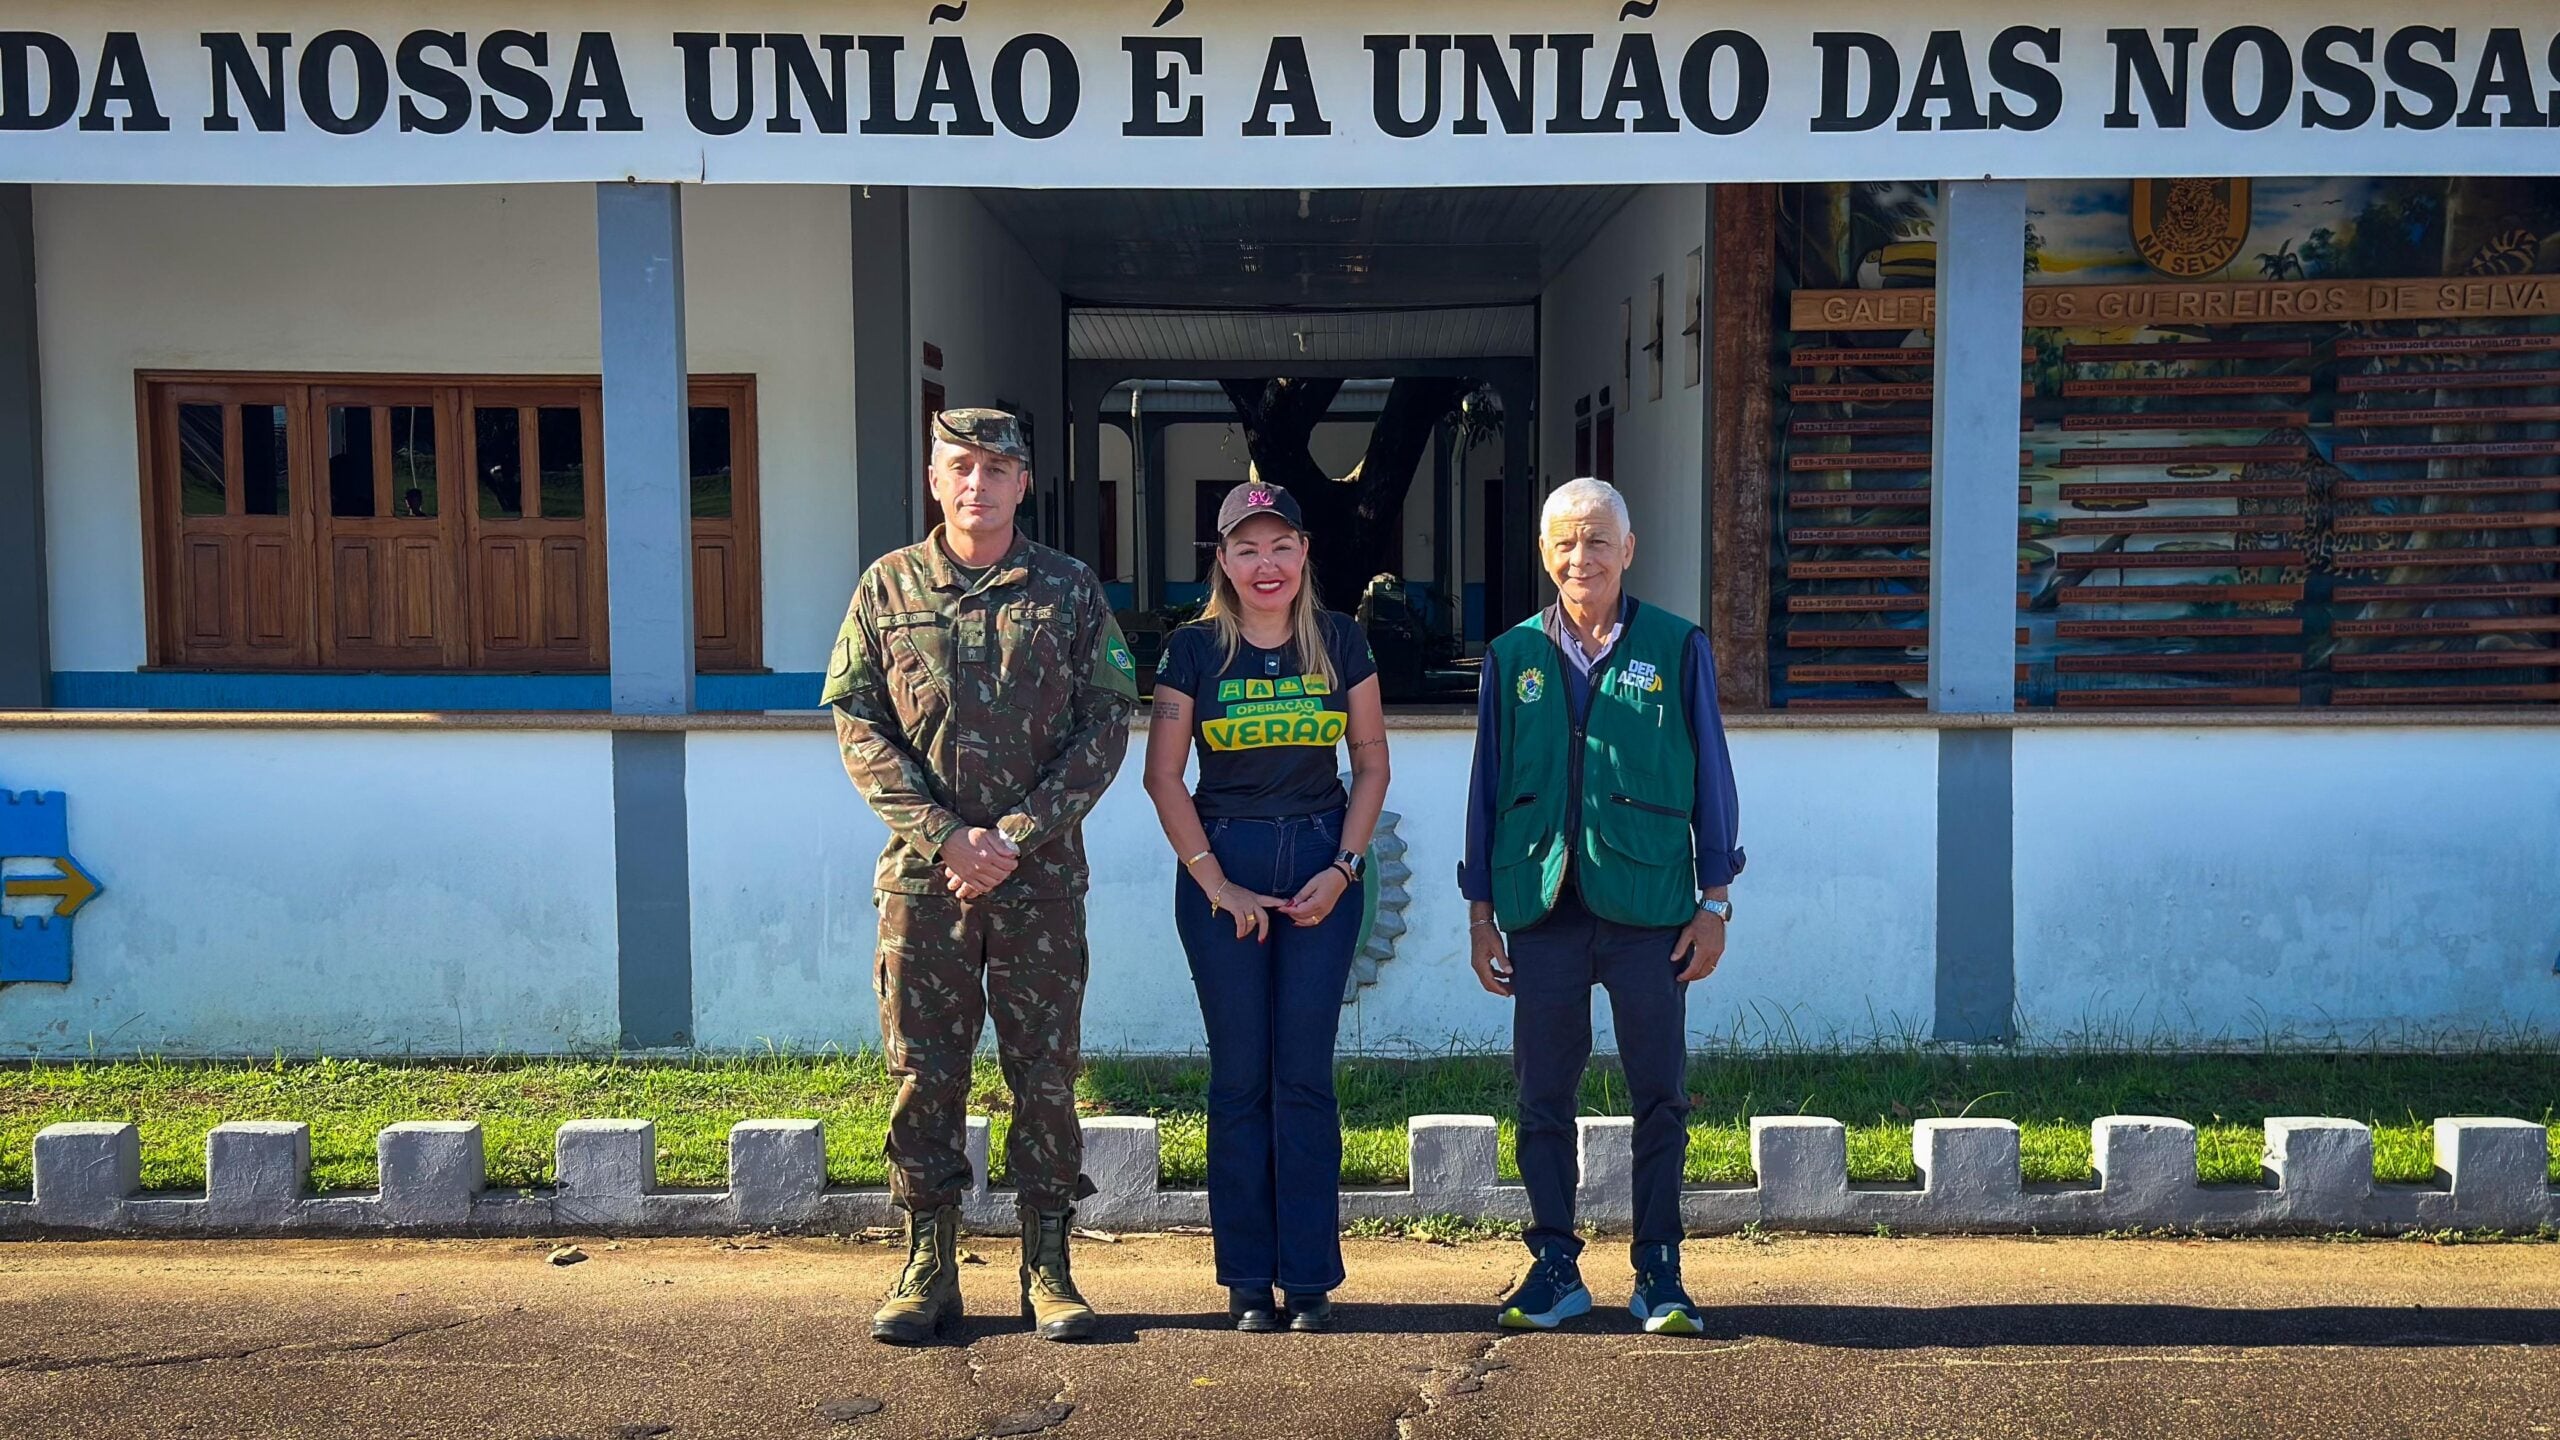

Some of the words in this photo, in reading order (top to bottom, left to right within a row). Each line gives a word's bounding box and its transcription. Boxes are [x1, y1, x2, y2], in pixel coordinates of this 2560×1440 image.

[0, 31, 171, 132] DA
[200, 29, 644, 135] NOSSA
[673, 0, 1081, 140] UNIÃO
[1121, 0, 1204, 137] É
[1241, 36, 1332, 137] A
[1363, 0, 1770, 138] UNIÃO
[1810, 25, 2063, 133] DAS
[2103, 25, 2560, 131] NOSSA
[2138, 234, 2165, 265] NA
[2171, 235, 2240, 274] SELVA
[1823, 296, 1936, 323] GALER
[2026, 290, 2077, 319] OS
[2097, 287, 2346, 320] GUERREIROS
[2368, 285, 2418, 313] DE
[2437, 281, 2549, 312] SELVA
[2432, 338, 2468, 349] CARLOS
[1617, 670, 1655, 691] ACRE
[1628, 659, 1656, 678] DER
[1236, 700, 1315, 715] OPERAÇÃO
[1210, 710, 1343, 748] VERÃO
